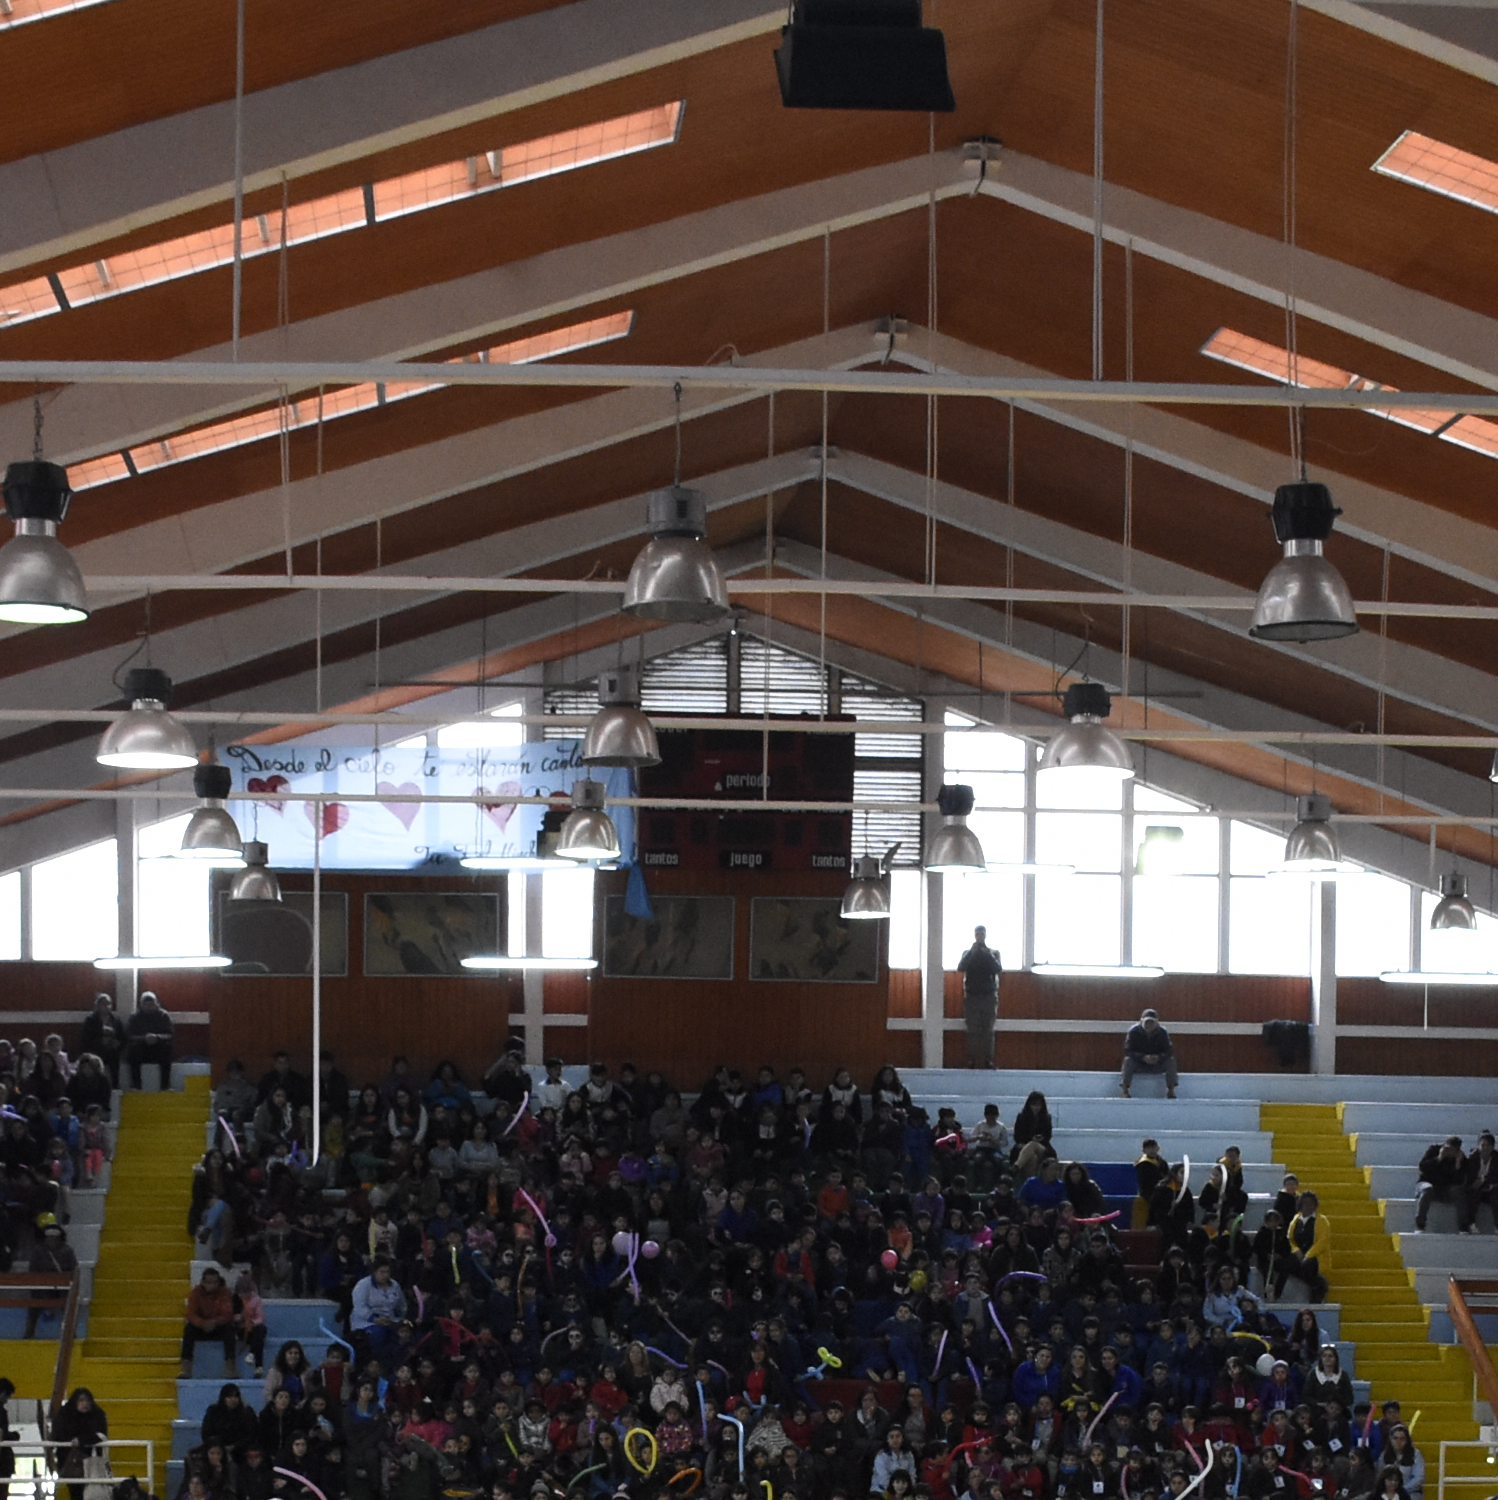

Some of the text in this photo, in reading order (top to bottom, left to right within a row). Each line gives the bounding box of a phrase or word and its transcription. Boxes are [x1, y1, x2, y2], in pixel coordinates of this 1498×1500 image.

[227, 745, 305, 774] Desde
[314, 748, 337, 771] el
[645, 851, 679, 865] tantos
[730, 851, 763, 868] juego
[812, 854, 846, 868] tantos
